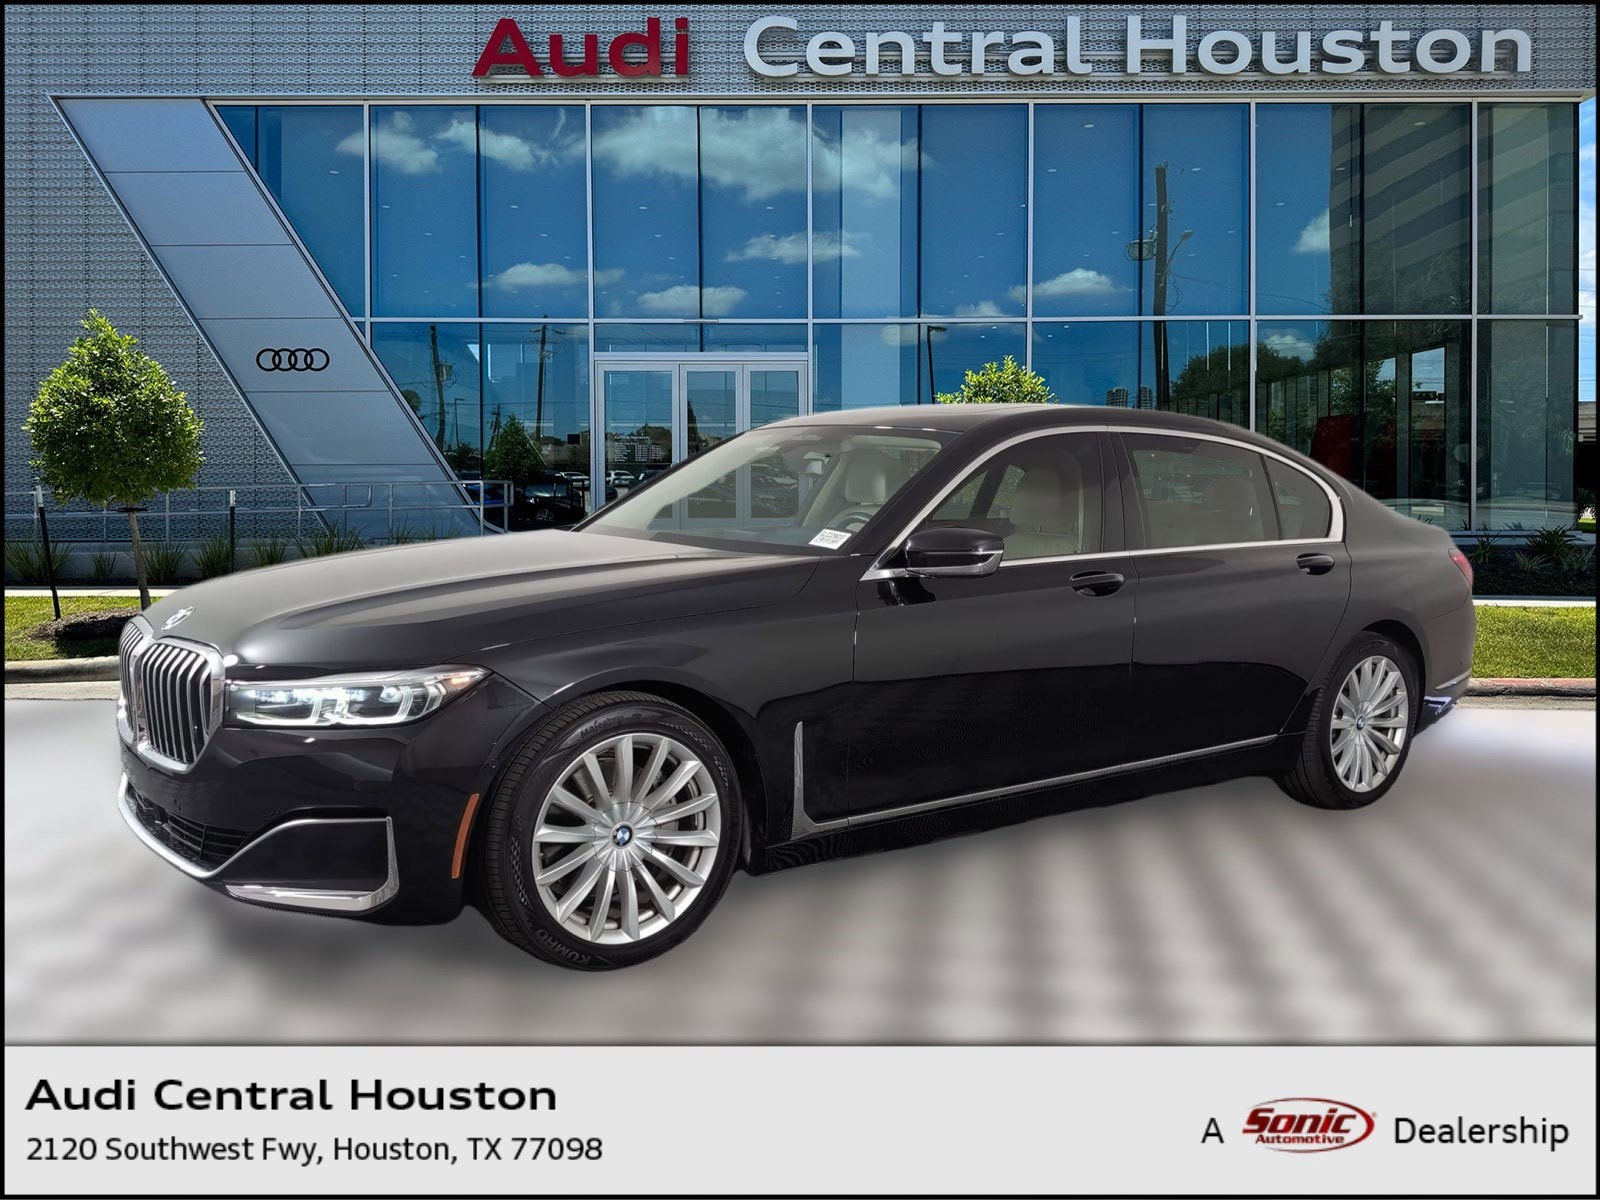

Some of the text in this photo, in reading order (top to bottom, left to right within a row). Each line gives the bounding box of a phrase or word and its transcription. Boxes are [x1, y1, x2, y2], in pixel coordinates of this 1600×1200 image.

[471, 15, 1532, 77] Audi Central Houston
[536, 928, 591, 964] KUMHO
